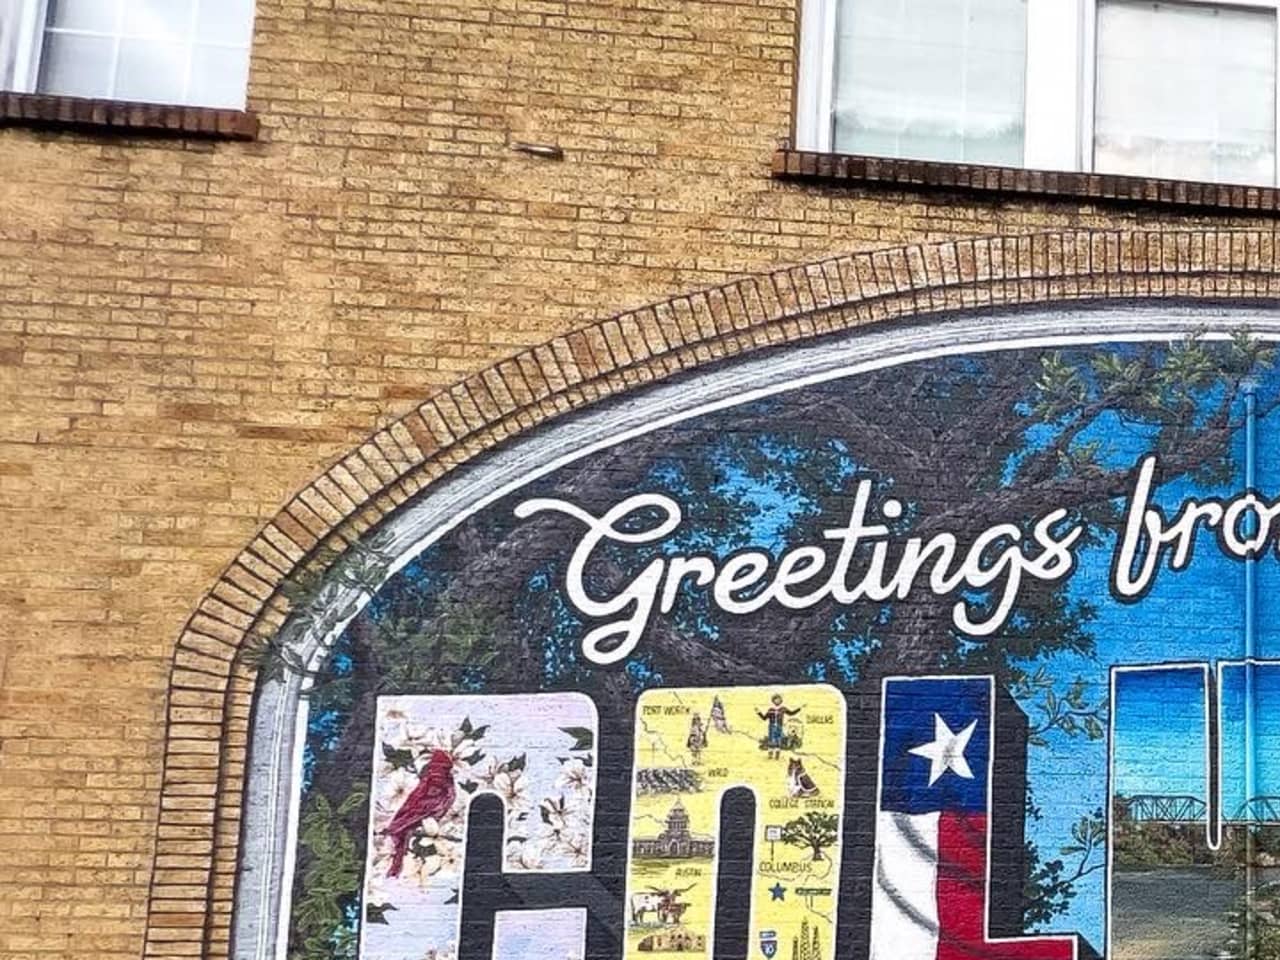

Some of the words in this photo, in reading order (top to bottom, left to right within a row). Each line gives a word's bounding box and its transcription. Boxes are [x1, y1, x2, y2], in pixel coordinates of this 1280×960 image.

[514, 479, 1082, 665] Greetings
[769, 799, 800, 810] COLLEGE
[759, 861, 813, 874] COLUMBUS
